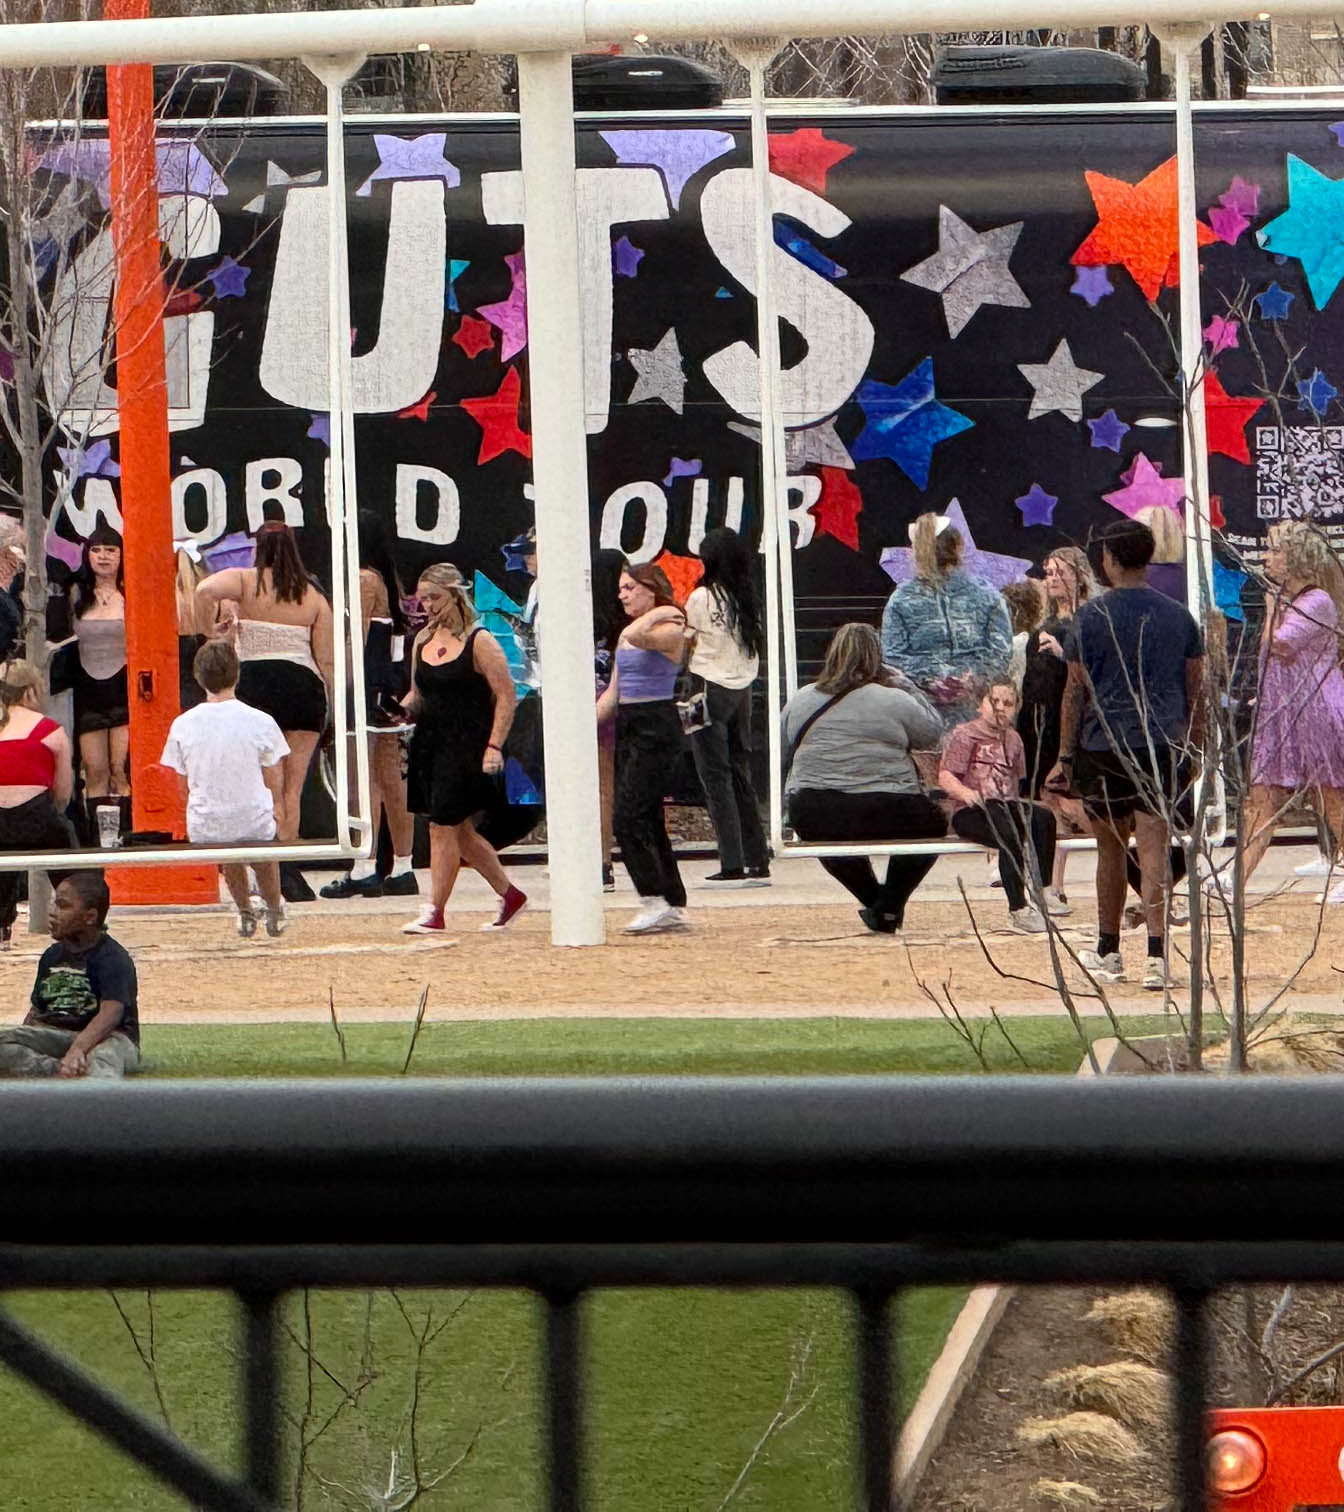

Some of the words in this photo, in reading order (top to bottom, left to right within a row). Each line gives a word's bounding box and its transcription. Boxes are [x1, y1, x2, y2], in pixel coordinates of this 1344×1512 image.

[43, 167, 875, 438] GUTS
[53, 457, 460, 546] WORD
[523, 474, 823, 565] OUR
